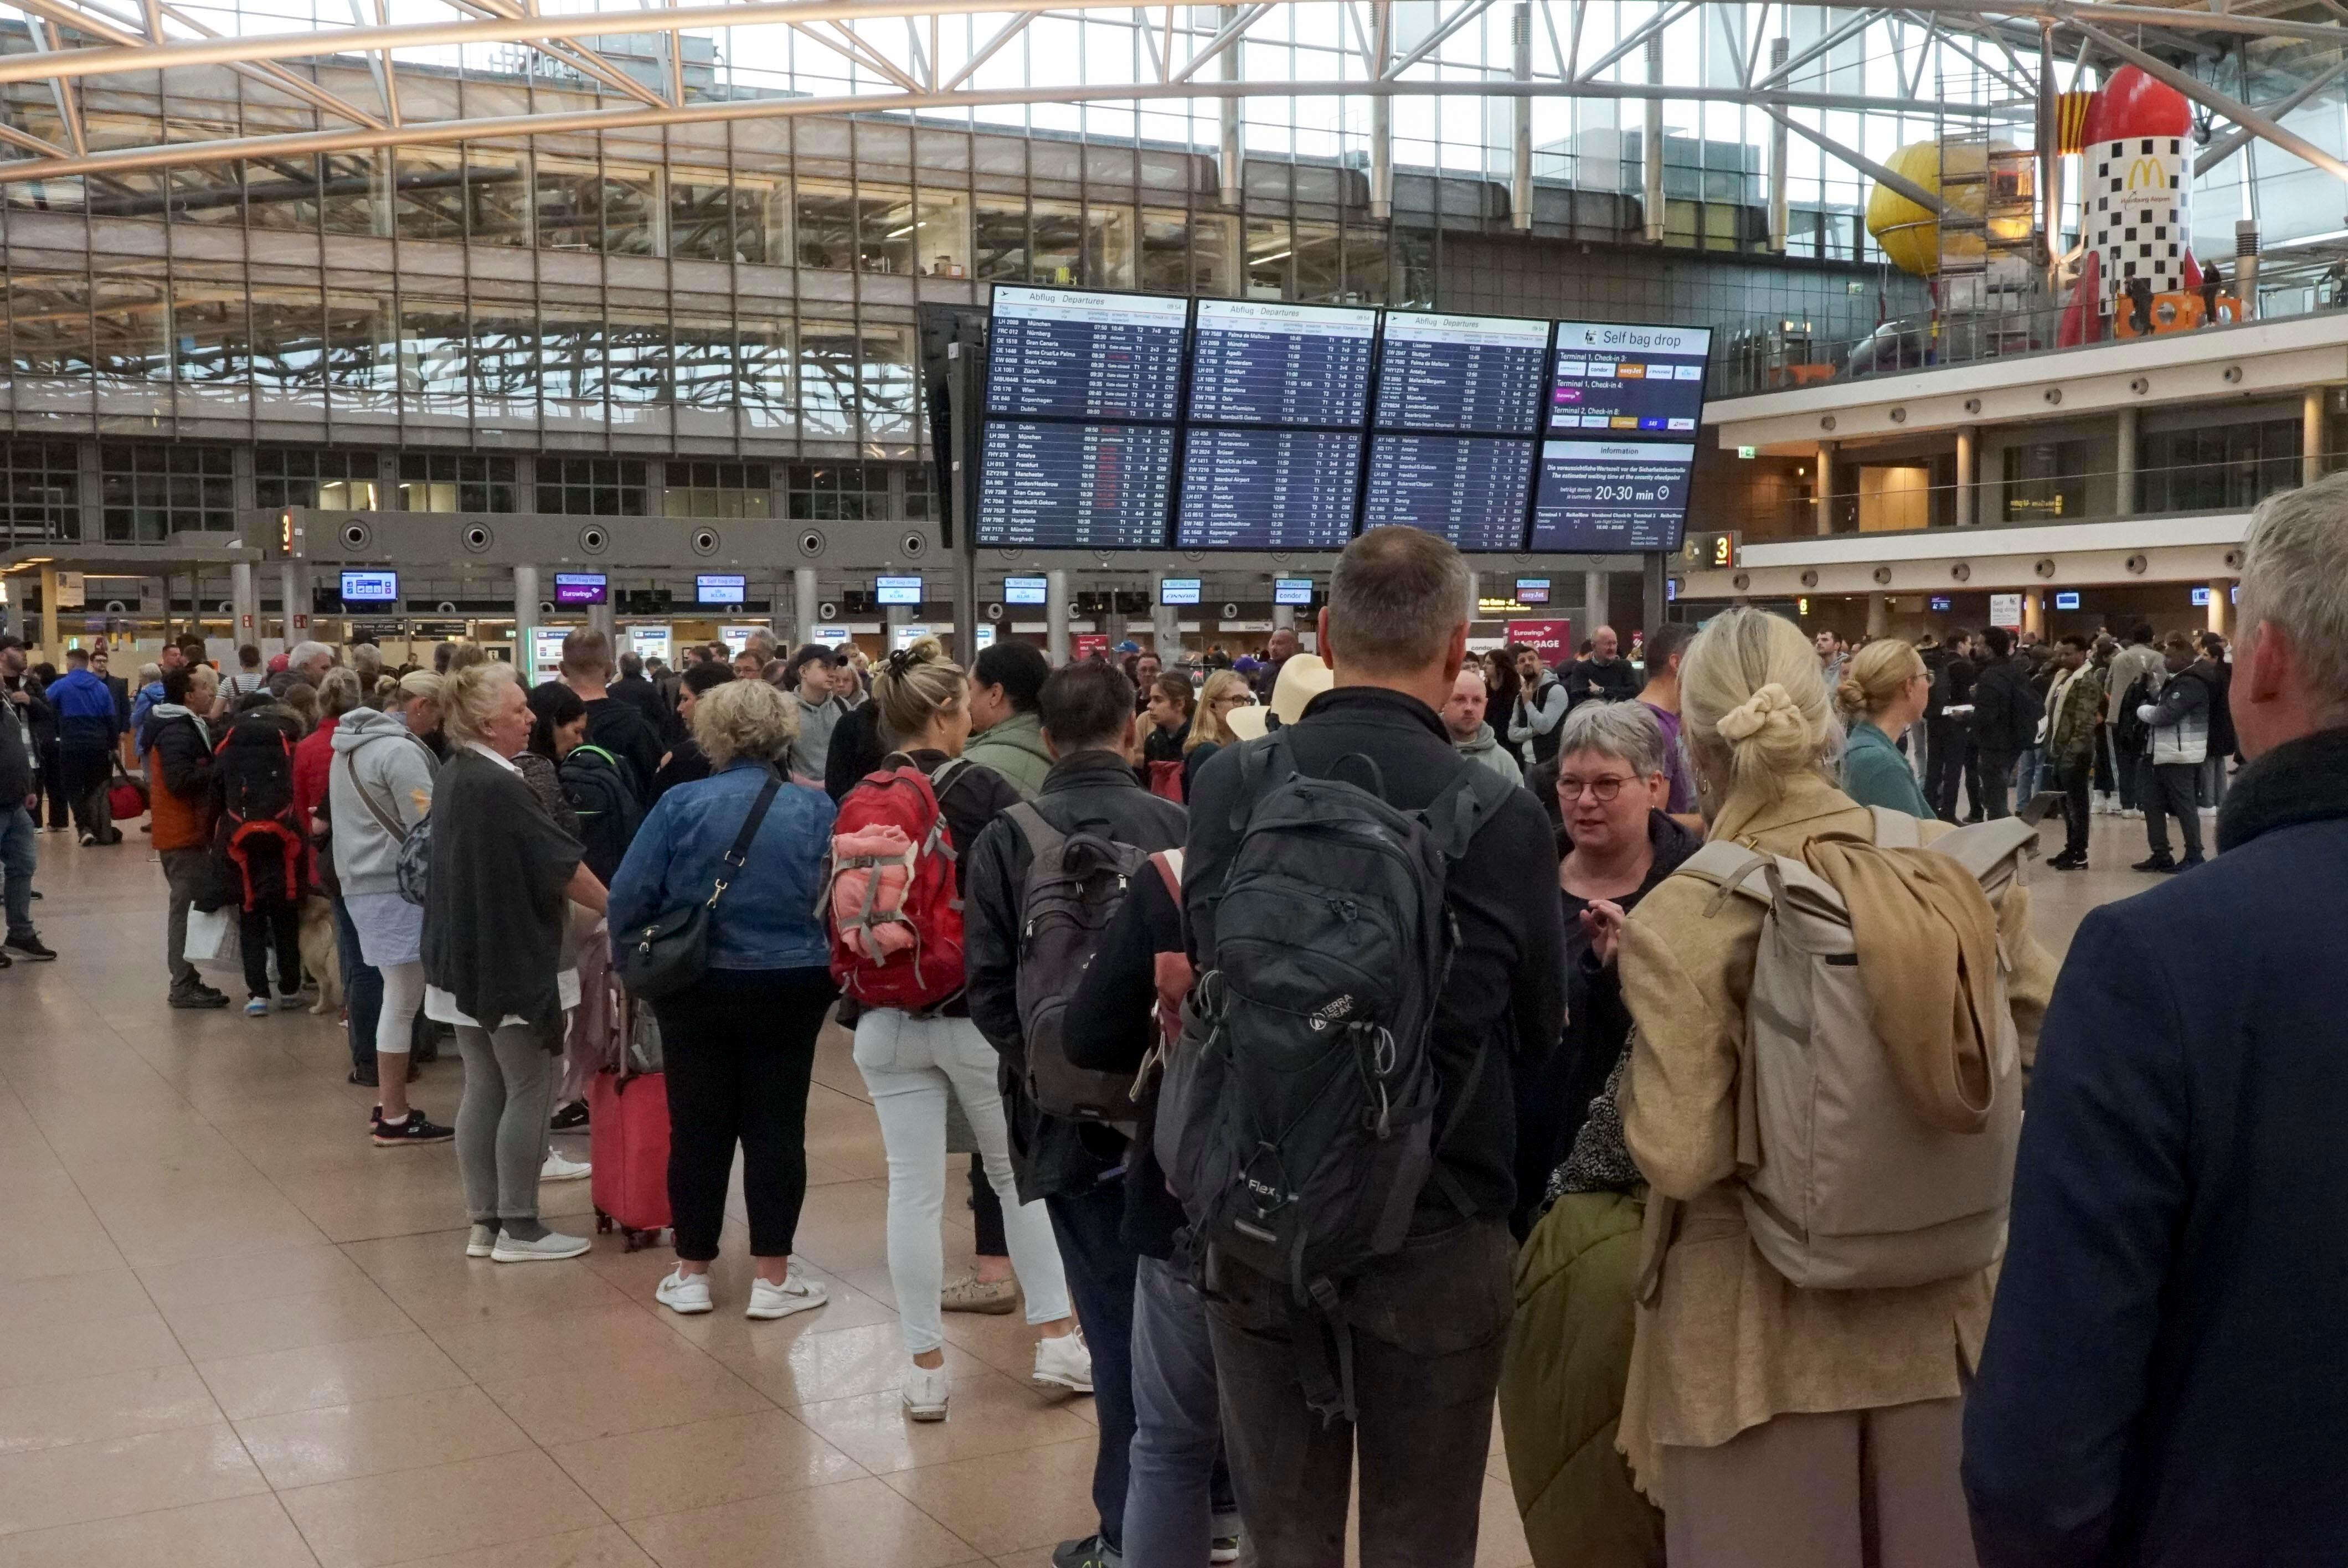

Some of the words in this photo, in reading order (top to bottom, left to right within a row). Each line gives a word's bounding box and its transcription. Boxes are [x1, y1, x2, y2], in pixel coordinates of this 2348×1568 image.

[1028, 292, 1055, 303] Abflug
[1062, 294, 1105, 306] Departures
[1230, 305, 1254, 315] Abflug
[1260, 307, 1300, 318] Departures
[1414, 317, 1438, 326] Abflug
[1443, 318, 1479, 328] Departures
[1026, 329, 1051, 338] Nürnberg
[1603, 330, 1626, 344] Self
[1629, 332, 1651, 348] bag
[1654, 333, 1681, 348] drop
[1559, 352, 1587, 360] Terminal
[1594, 353, 1620, 362] Check-in
[1619, 367, 1642, 375] easyJet
[1556, 379, 1583, 387] Terminal
[1600, 446, 1639, 455] Information
[1594, 484, 1633, 500] 20-30
[1635, 489, 1655, 500] min
[283, 515, 290, 543] 3
[1717, 538, 1728, 559] 3
[1800, 599, 1808, 611] 6
[1321, 994, 1353, 1015] TERRA
[1248, 1179, 1275, 1196] Flex
